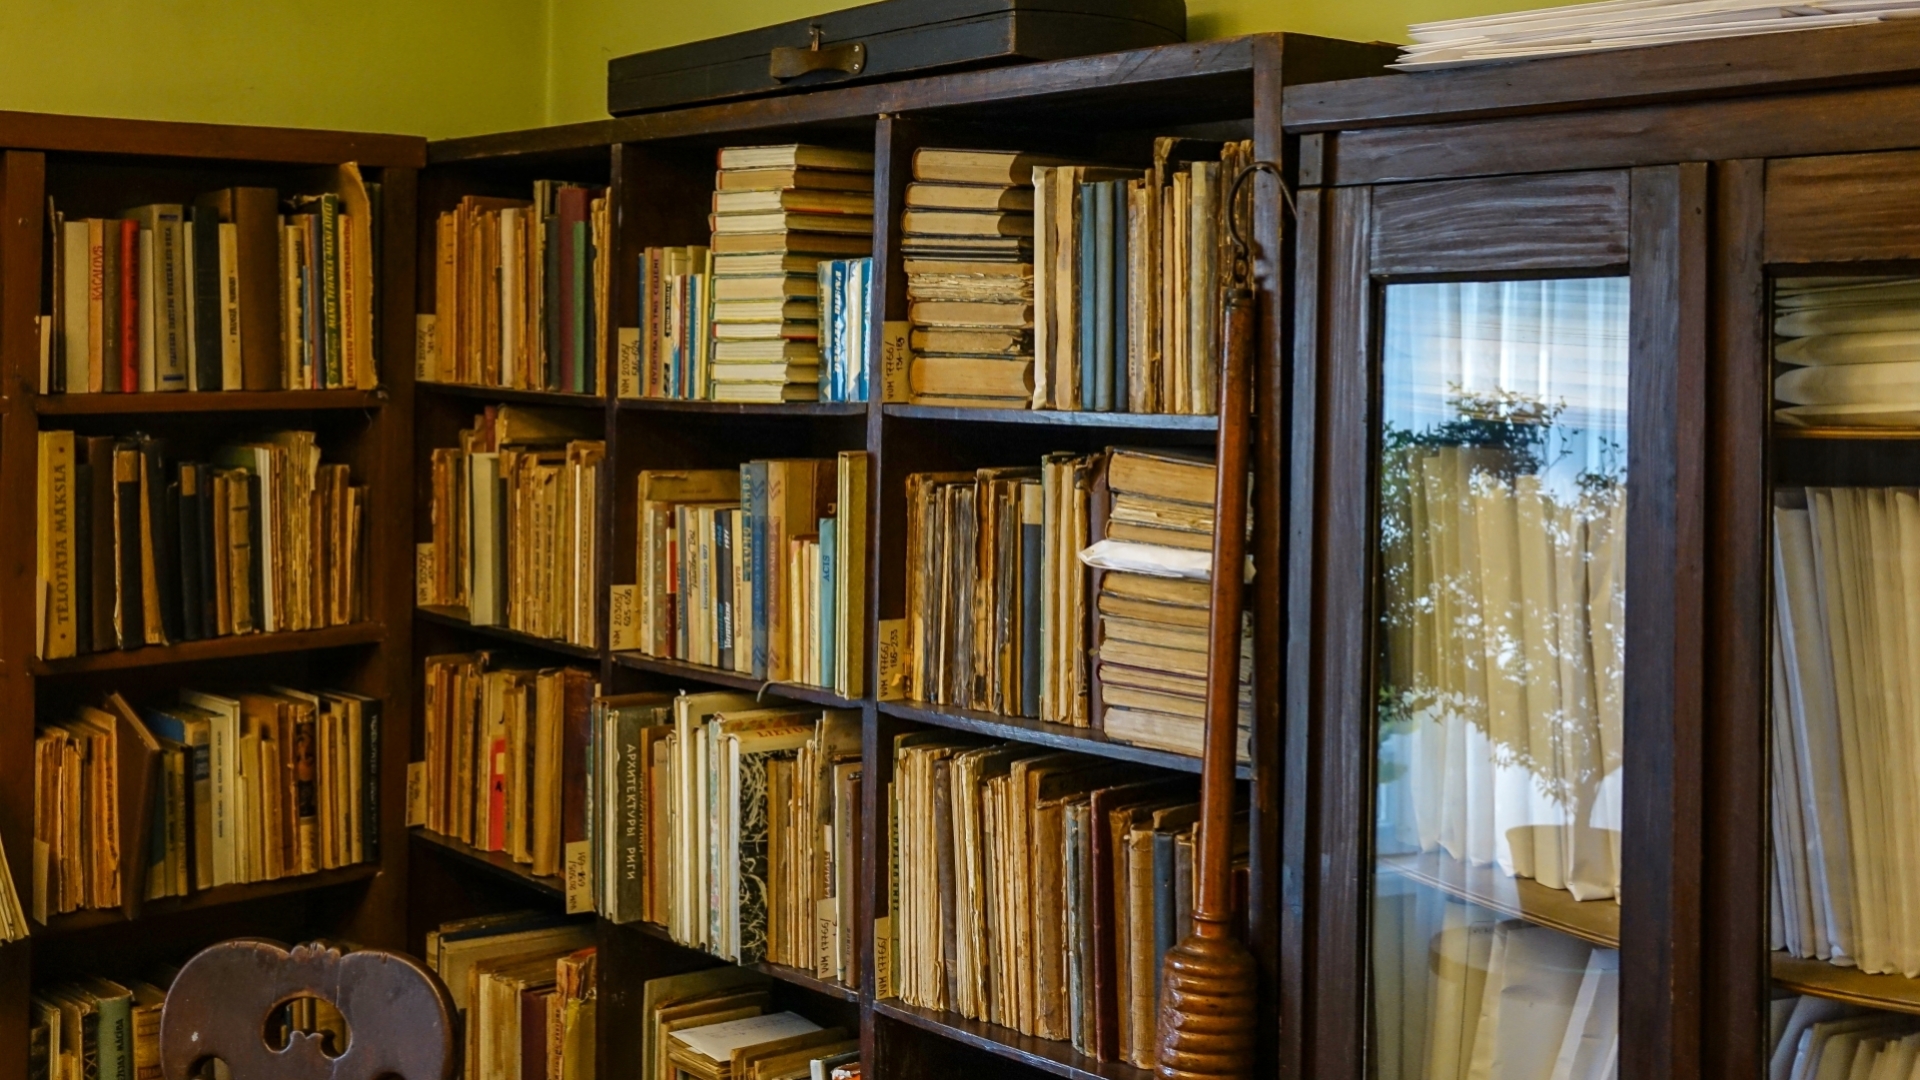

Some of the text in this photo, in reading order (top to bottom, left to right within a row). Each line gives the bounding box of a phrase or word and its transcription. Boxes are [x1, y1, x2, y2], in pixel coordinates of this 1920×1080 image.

[822, 554, 831, 583] ACIS
[627, 743, 638, 880] АРХИТЕКТУРЫ РИГИ
[819, 917, 831, 952] 17766/
[876, 936, 888, 973] 17766/
